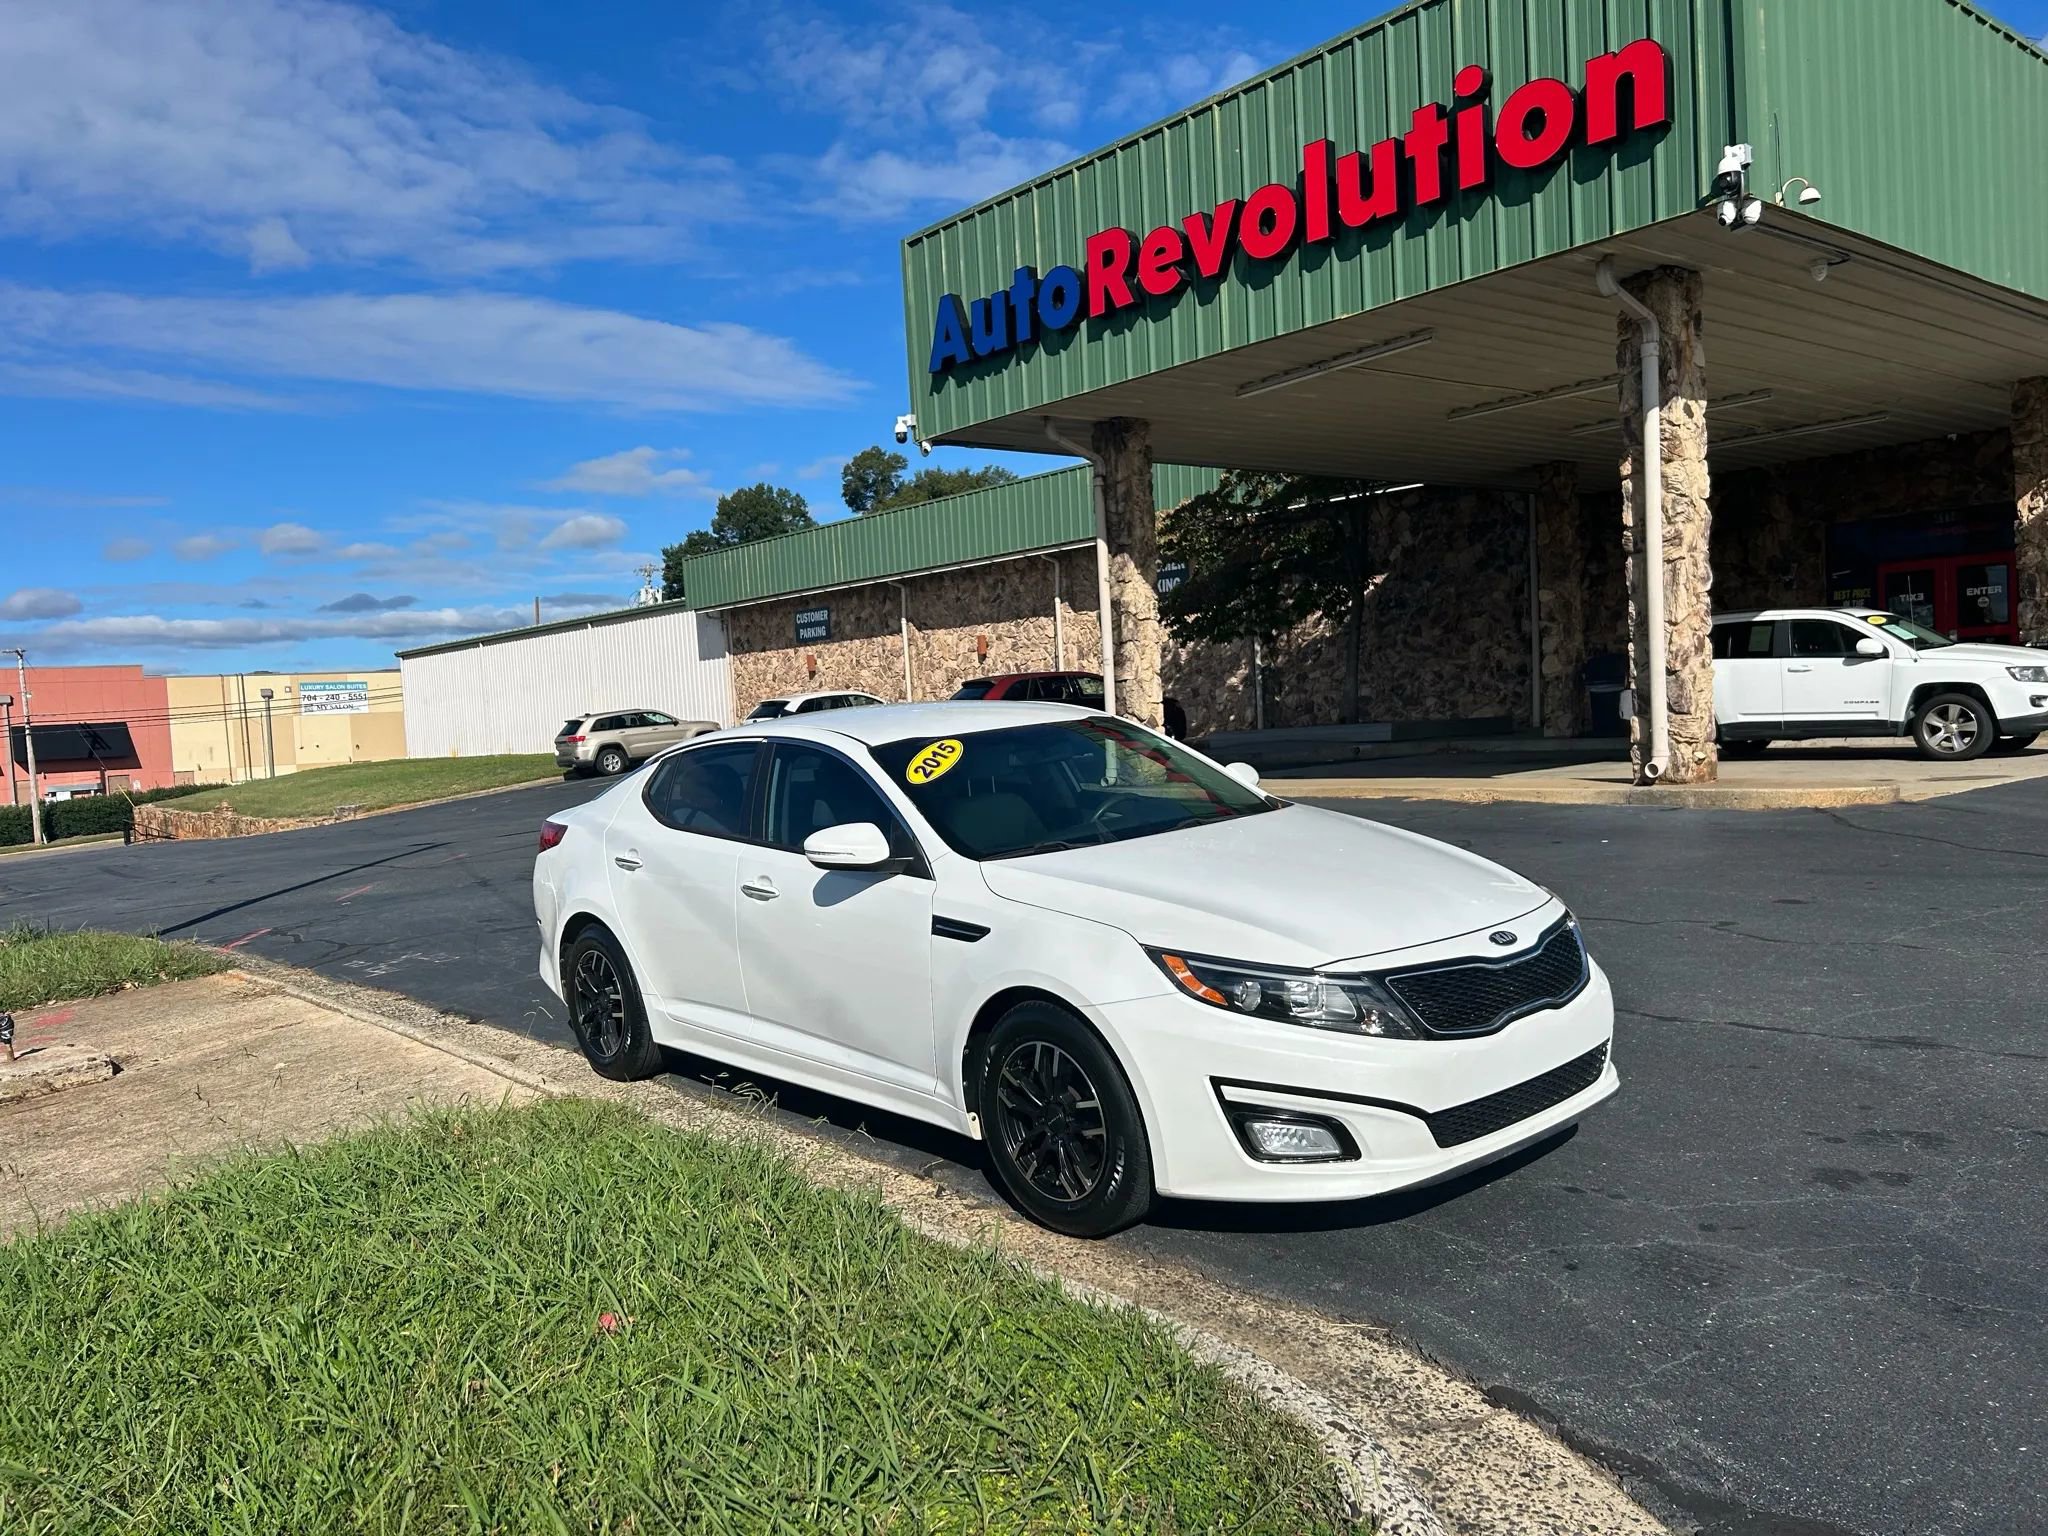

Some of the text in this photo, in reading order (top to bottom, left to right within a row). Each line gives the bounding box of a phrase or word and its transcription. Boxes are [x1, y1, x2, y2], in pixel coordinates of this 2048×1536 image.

[928, 37, 1674, 375] AutoRevolution
[1966, 585, 2002, 597] ENTER
[796, 609, 829, 624] CUSTOMER
[800, 625, 827, 639] PARKING
[302, 694, 317, 702] 704
[325, 693, 340, 701] 240
[348, 693, 368, 701] 5551
[913, 742, 956, 779] 2015
[1491, 931, 1516, 944] KIA
